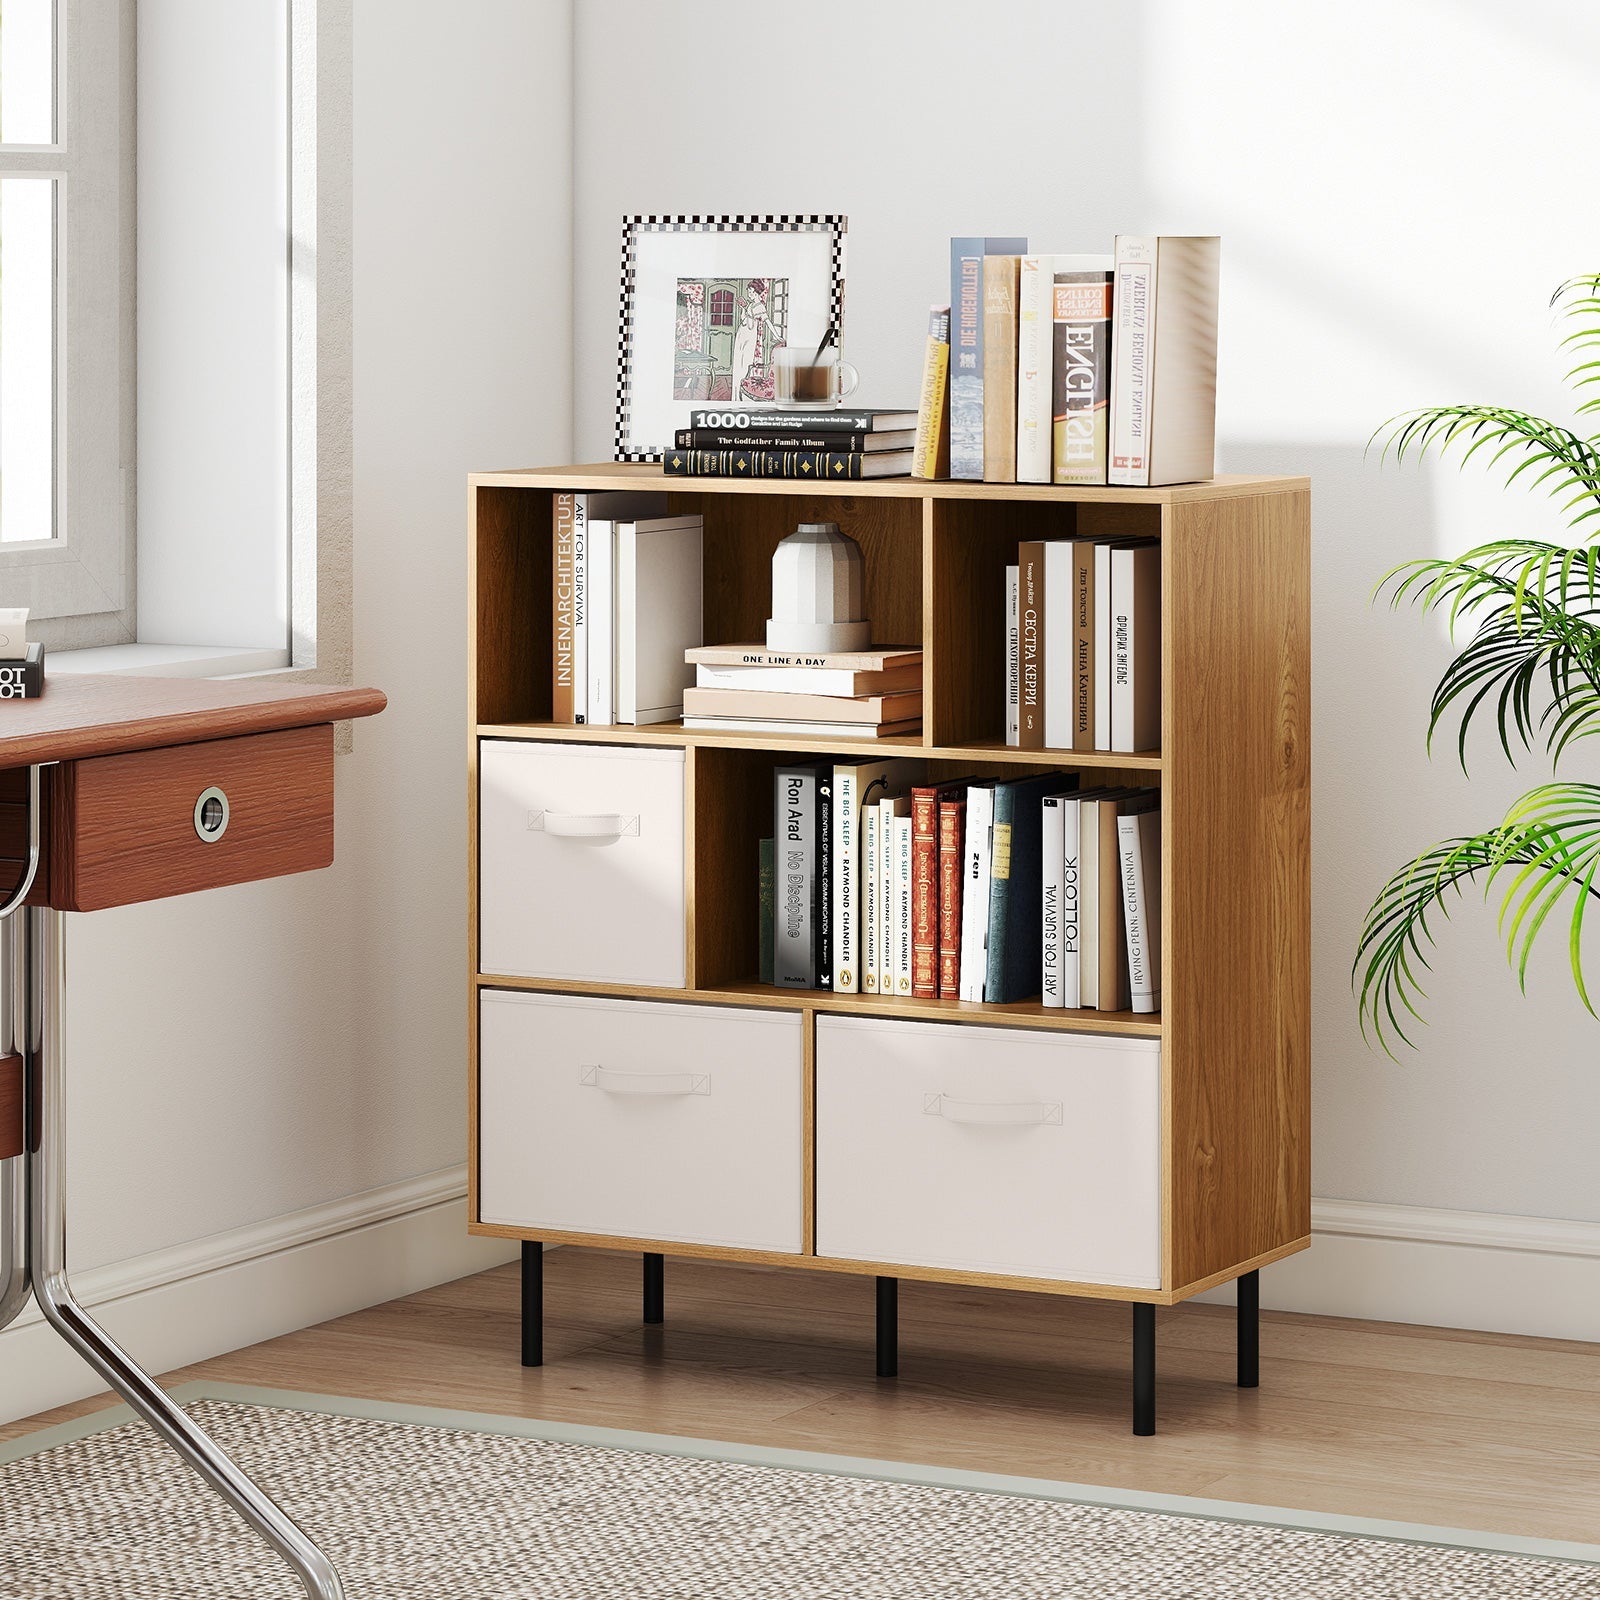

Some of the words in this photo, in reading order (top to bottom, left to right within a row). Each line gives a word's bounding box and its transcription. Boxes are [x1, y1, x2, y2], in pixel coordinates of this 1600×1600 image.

[696, 413, 750, 428] 1000
[734, 437, 772, 445] Godfather
[774, 438, 800, 448] Family
[575, 503, 584, 528] ART
[575, 534, 584, 561] FOR
[557, 494, 571, 687] INNENARCHITEKTUR
[575, 566, 584, 627] SURVIVAL
[1025, 609, 1037, 660] СЕСТРА
[1116, 615, 1128, 650] ФРИДРИХ
[743, 655, 763, 663] ONE
[769, 657, 791, 665] LINE
[806, 658, 825, 666] DAY
[1010, 627, 1018, 705] СТИХОТВОРЕНИЯ
[1116, 653, 1128, 685] ЭНГЕЛЬС
[1025, 664, 1037, 705] КЕРРИ
[788, 778, 803, 805] Ron
[788, 809, 803, 841] Arad
[788, 851, 803, 870] No
[822, 844, 829, 853] OF
[1125, 850, 1138, 912] CENTENNIAL
[784, 874, 803, 938] Discipline
[1045, 884, 1057, 940] SURVIVAL
[1065, 856, 1078, 953] POLLOCK
[1130, 915, 1141, 944] PENN:
[1045, 943, 1057, 968] FOR
[1132, 947, 1144, 985] IRVING
[1045, 972, 1057, 996] ART
